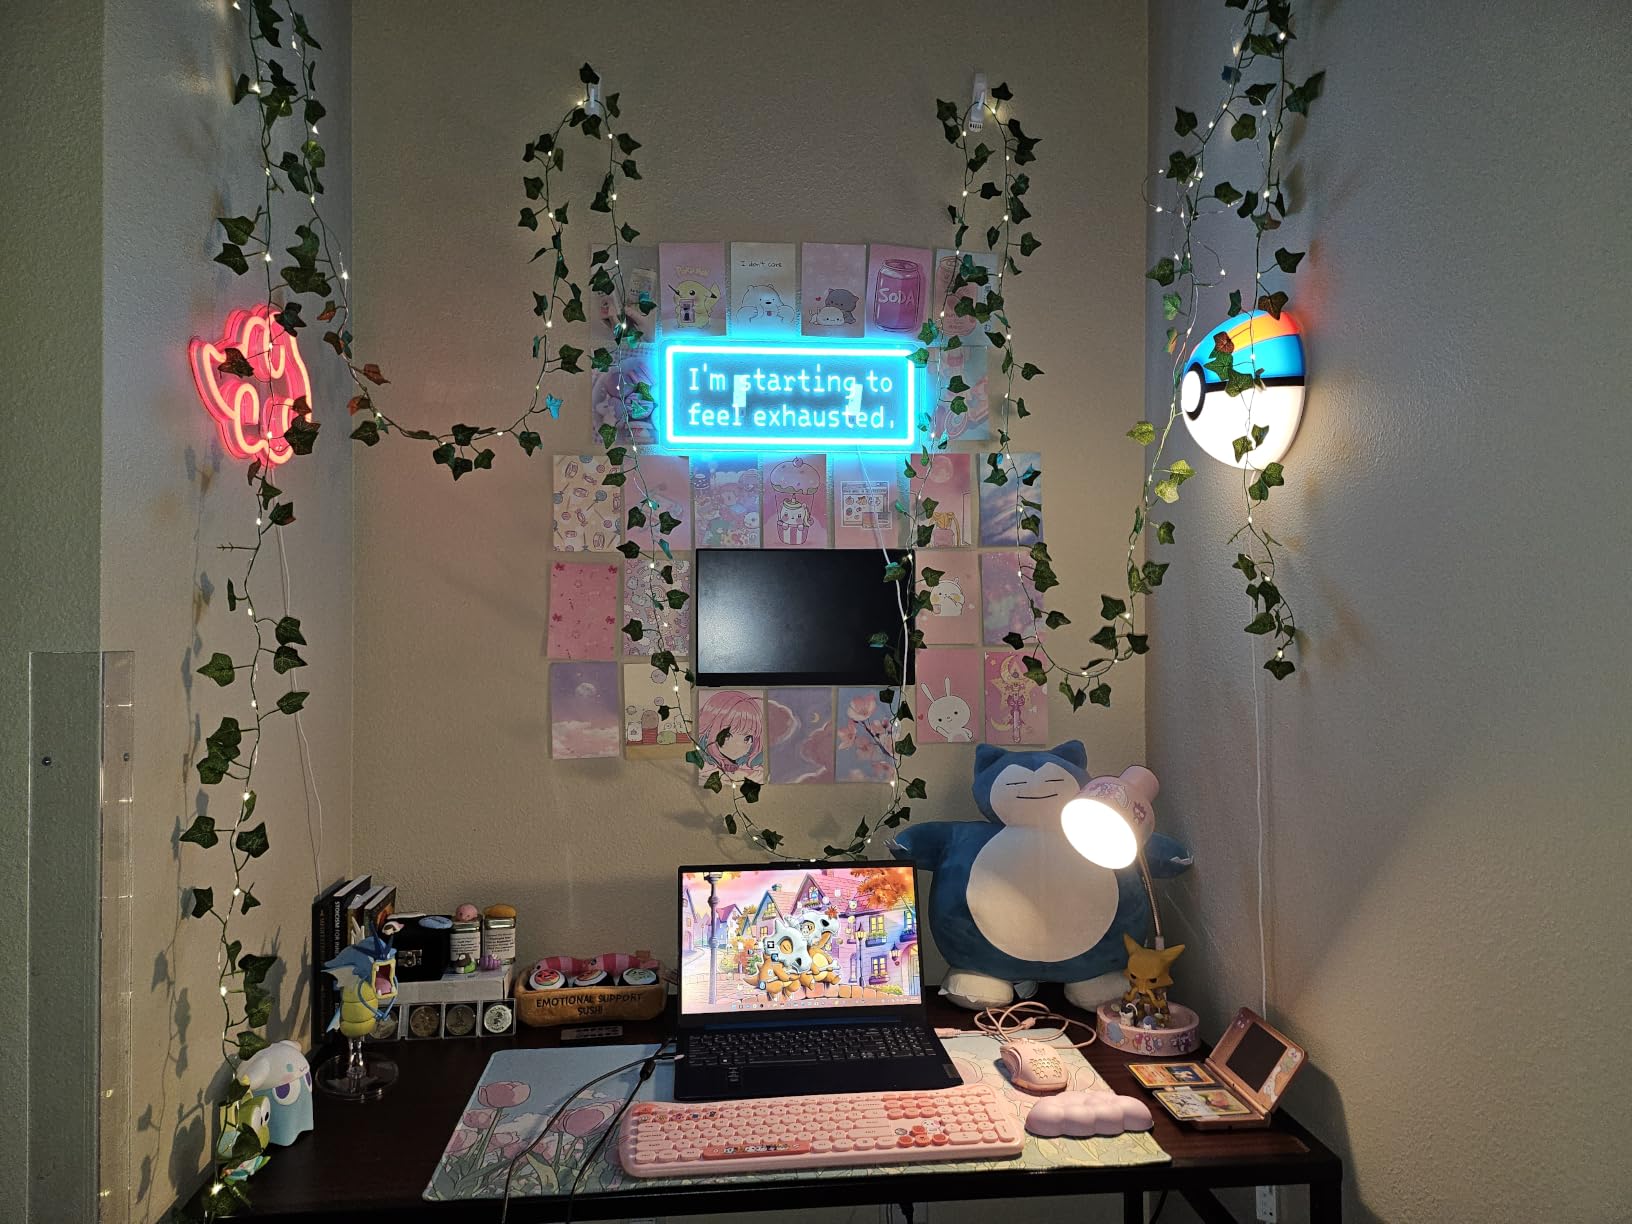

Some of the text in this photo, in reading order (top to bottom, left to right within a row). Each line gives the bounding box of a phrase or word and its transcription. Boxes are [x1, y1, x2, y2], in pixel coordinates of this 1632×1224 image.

[688, 363, 893, 399] I'm starting to
[688, 403, 742, 427] feel
[536, 993, 642, 1008] EMOTIONAL SUPPORT
[577, 1007, 603, 1016] SUSHI
